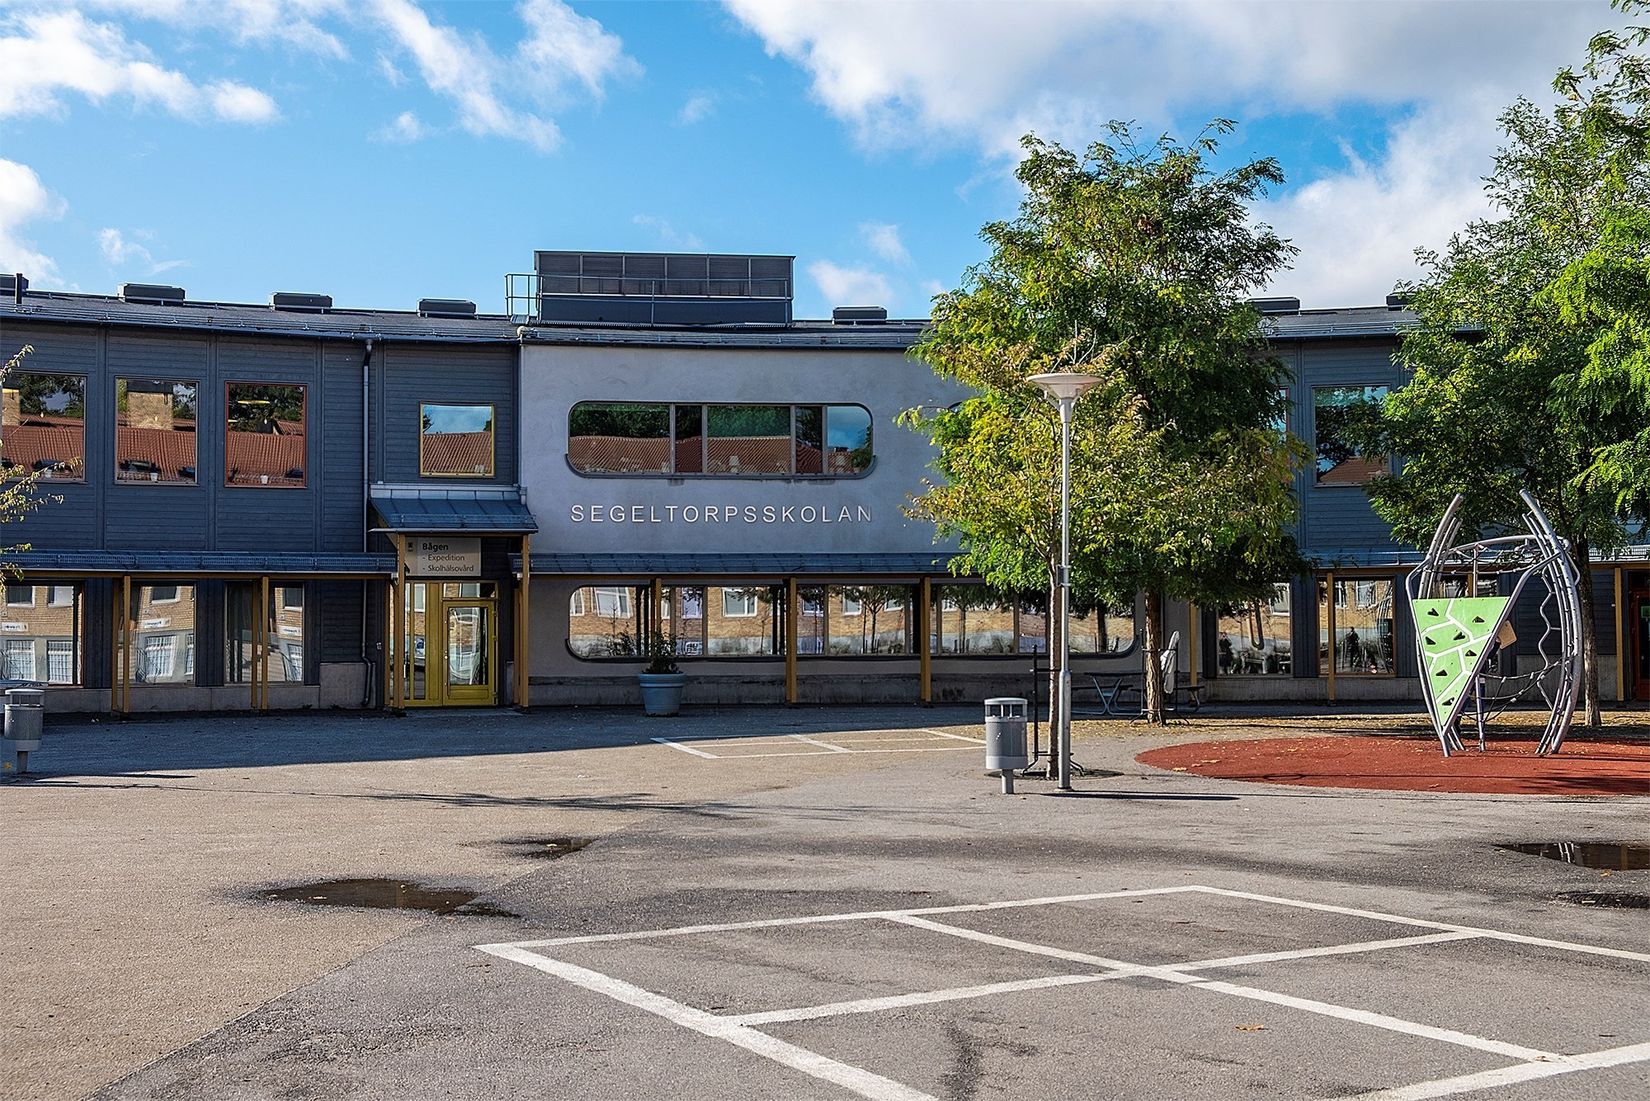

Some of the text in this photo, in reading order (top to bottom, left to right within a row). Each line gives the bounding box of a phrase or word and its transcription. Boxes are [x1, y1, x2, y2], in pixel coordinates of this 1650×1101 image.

[570, 504, 872, 523] SEGELTORPSSKOLAN
[422, 542, 449, 552] Bågen
[427, 554, 465, 562] Expedition
